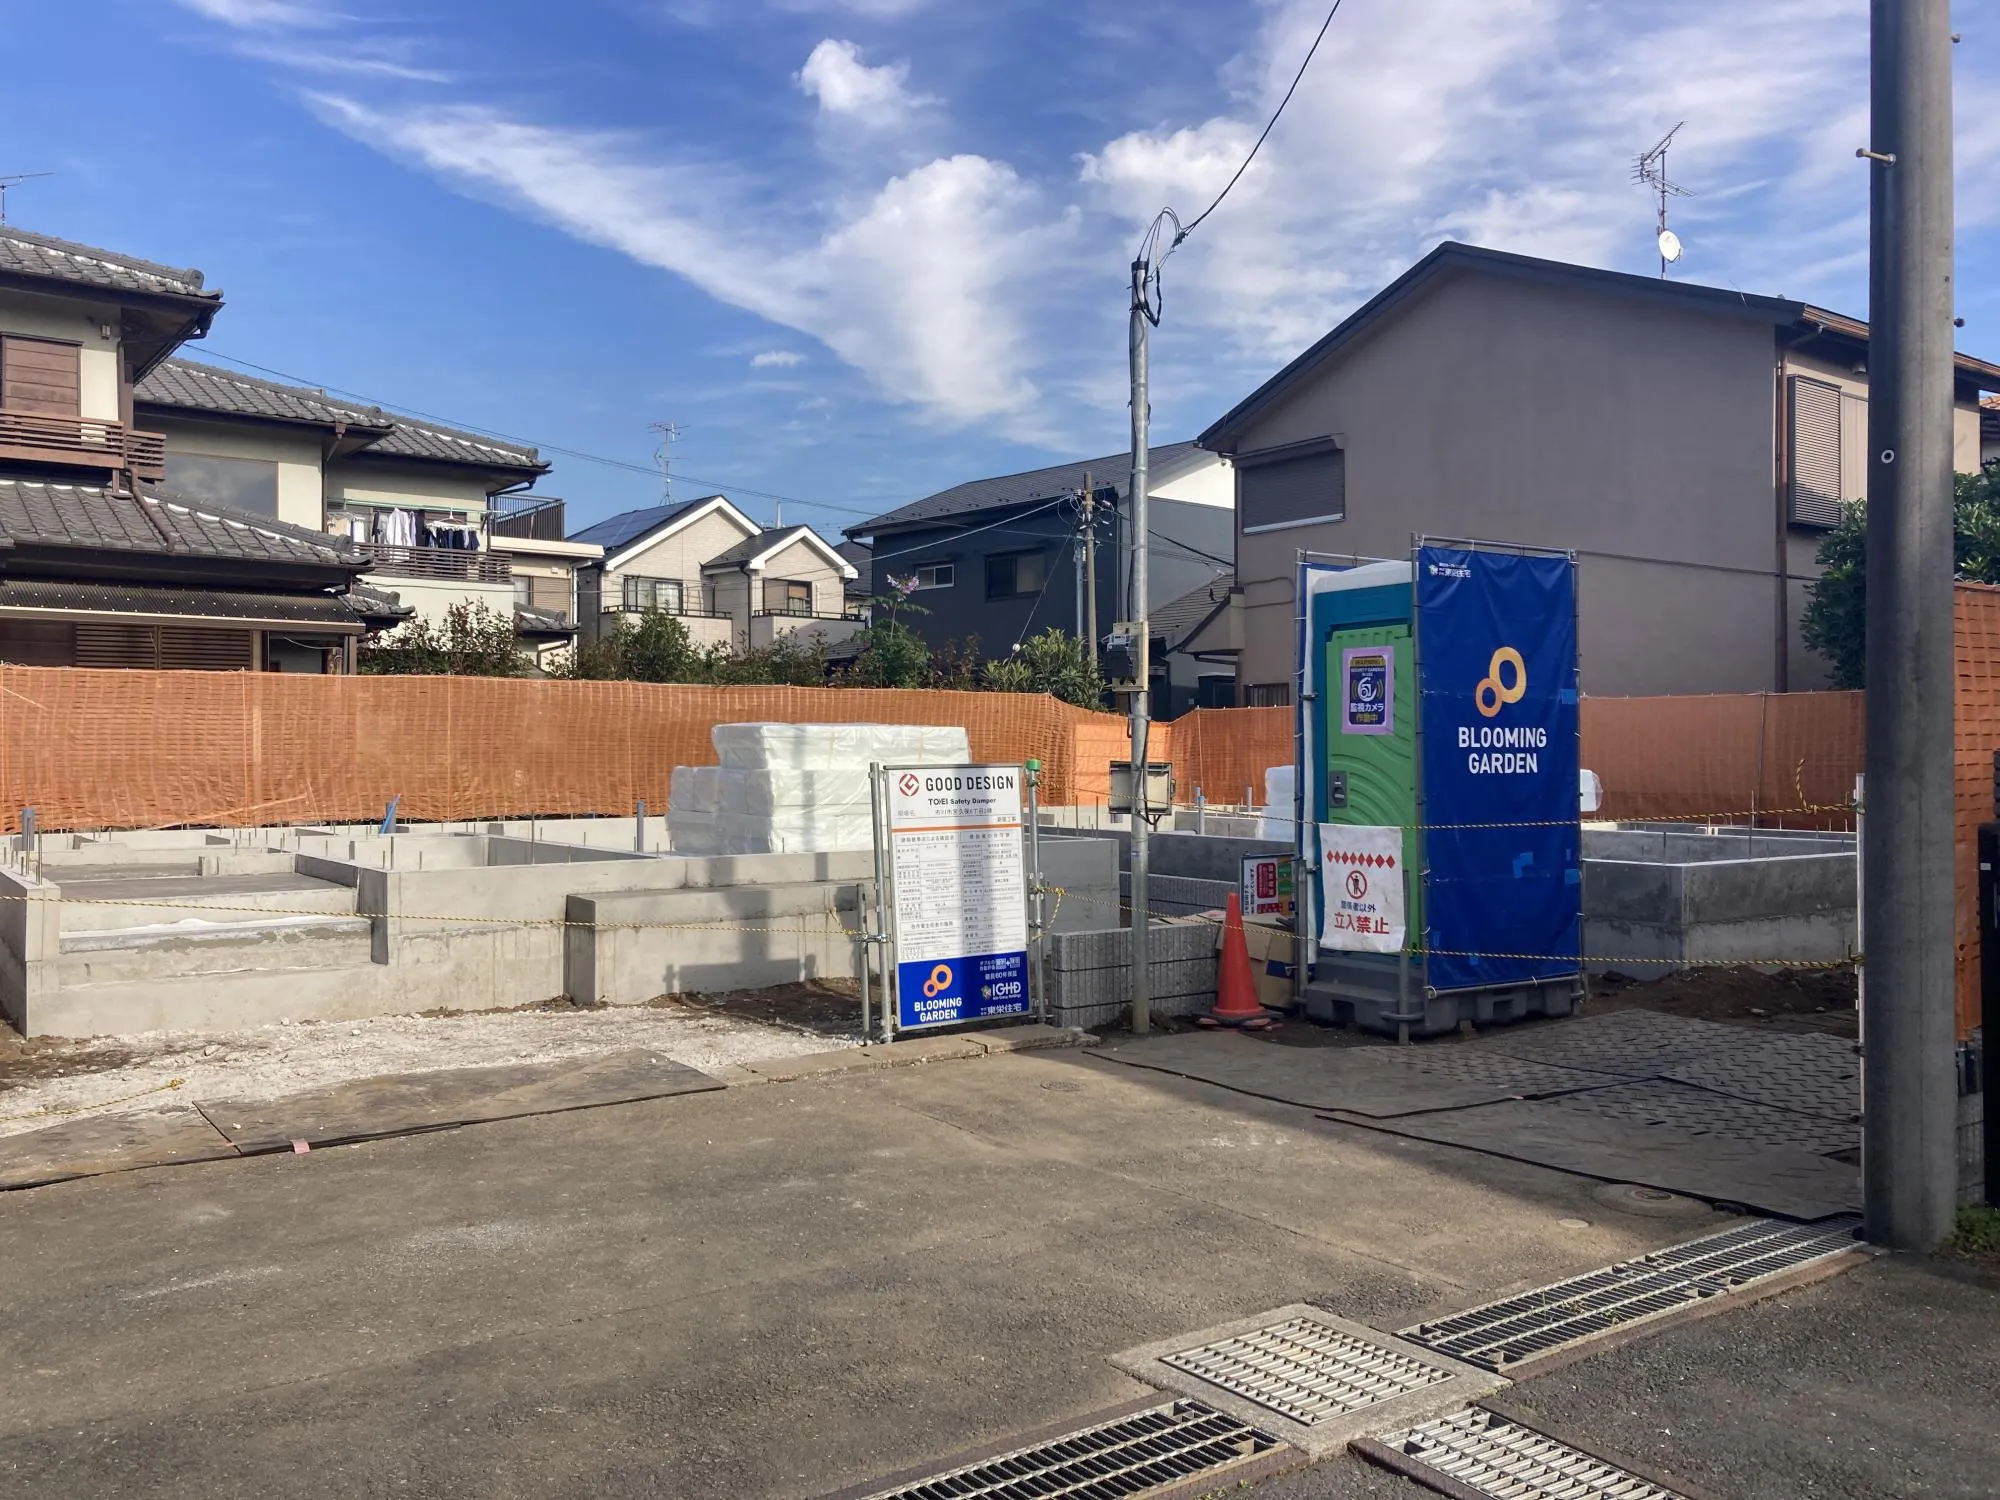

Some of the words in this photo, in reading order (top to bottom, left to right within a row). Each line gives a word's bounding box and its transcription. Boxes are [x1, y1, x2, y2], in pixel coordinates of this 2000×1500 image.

[1350, 702, 1384, 713] 監視カメラ
[1458, 726, 1547, 748] BLOOMING
[1468, 753, 1538, 774] GARDEN
[925, 777, 962, 792] GOOD
[966, 775, 1014, 790] DESIGN
[928, 798, 949, 806] TOEI
[950, 797, 971, 806] Safety
[972, 797, 997, 805] Damper
[1334, 911, 1390, 934] 立入禁止
[992, 981, 1021, 996] IGHD
[914, 997, 962, 1012] BLOOMING
[920, 1008, 957, 1022] GARDEN
